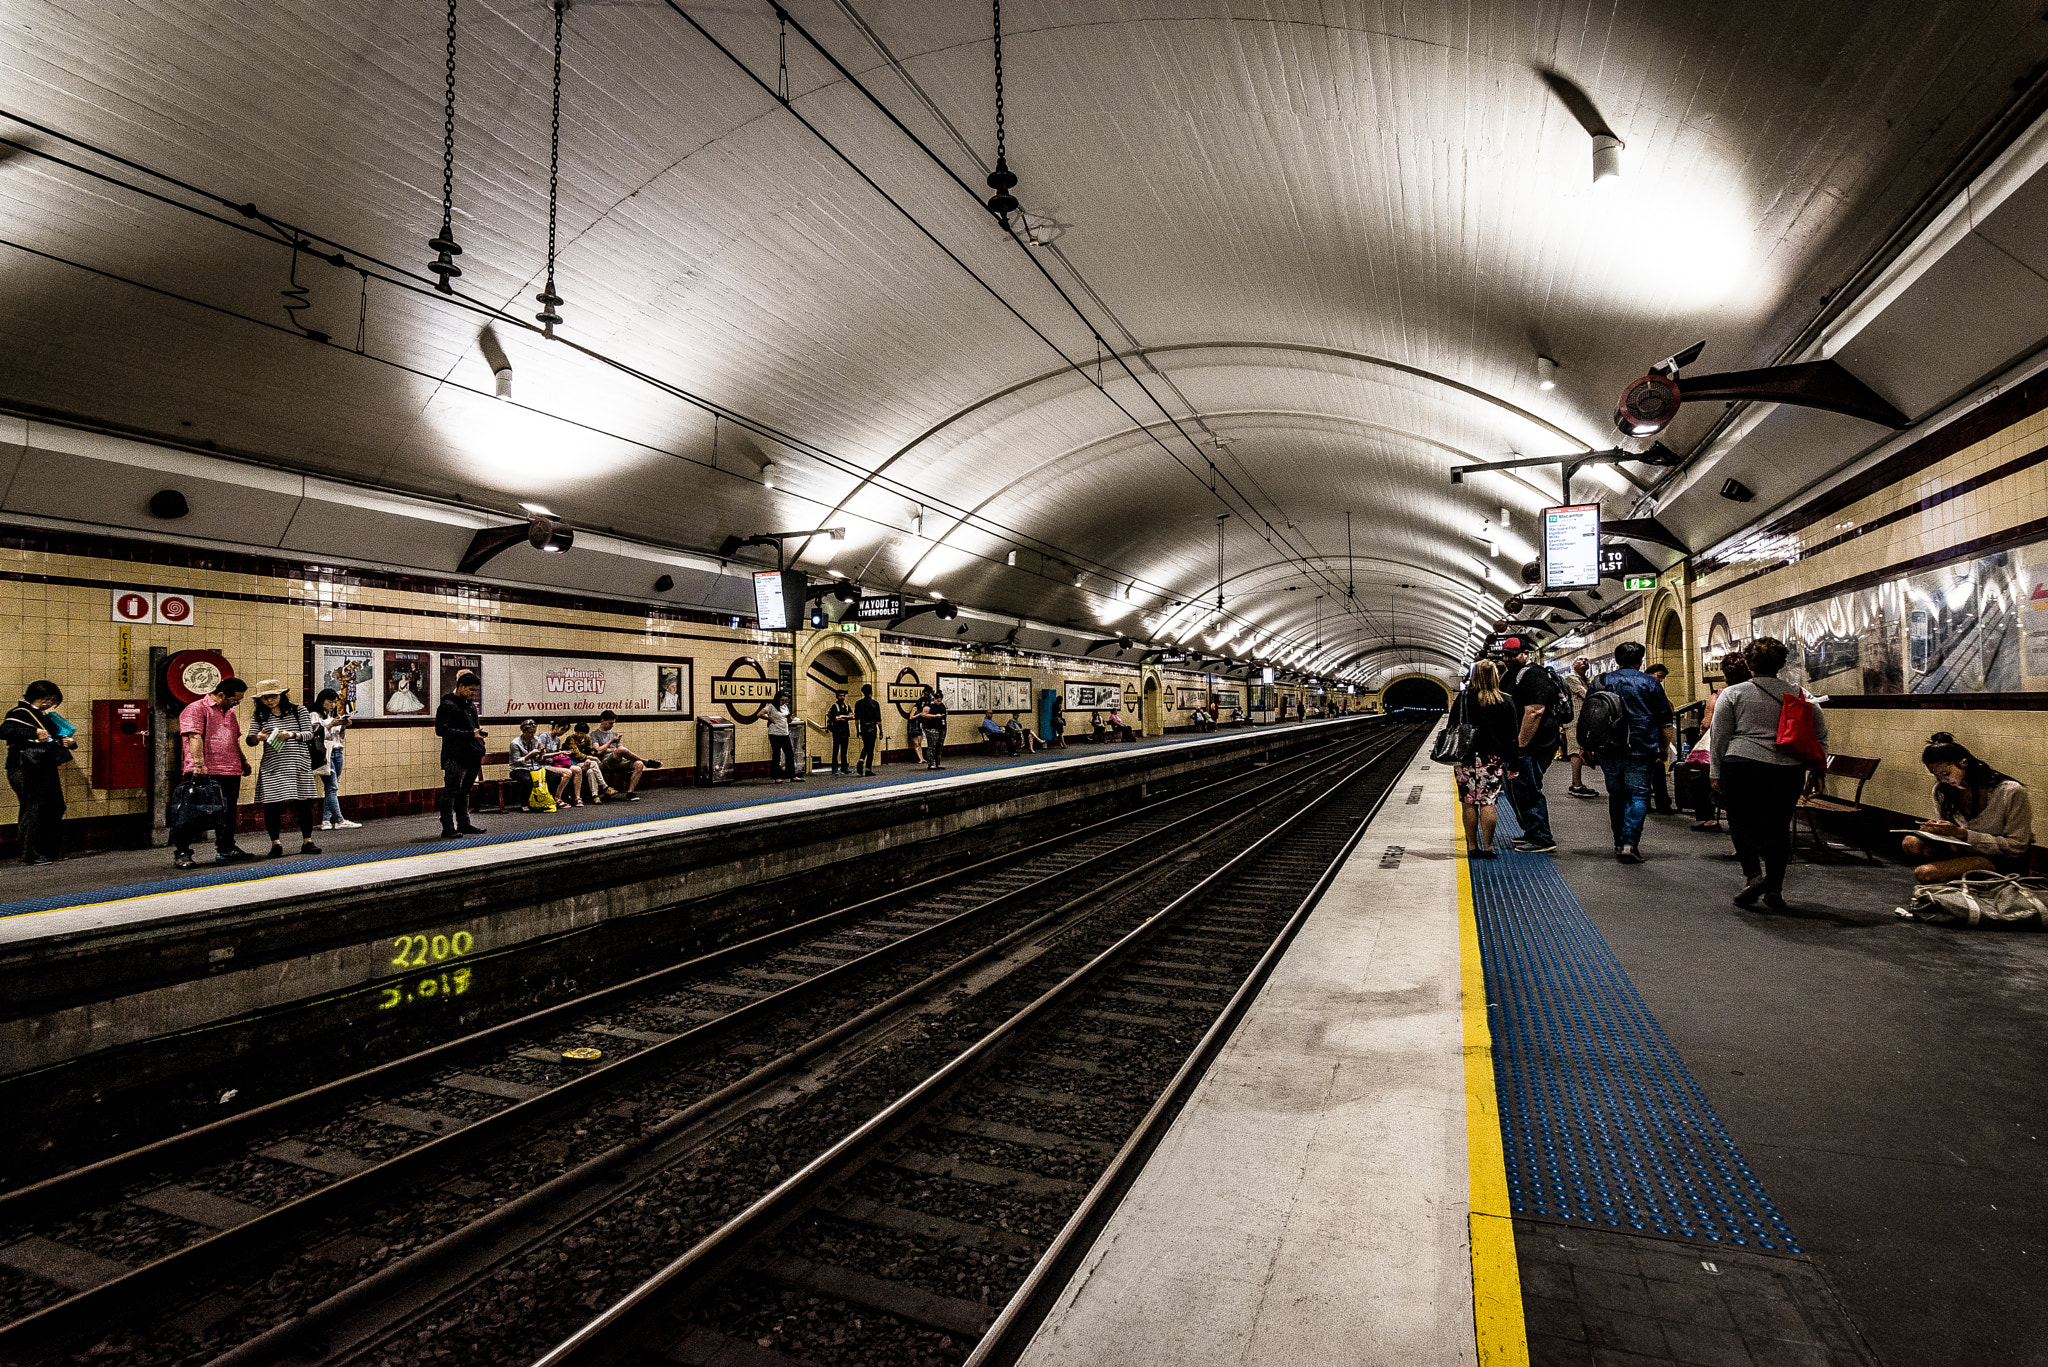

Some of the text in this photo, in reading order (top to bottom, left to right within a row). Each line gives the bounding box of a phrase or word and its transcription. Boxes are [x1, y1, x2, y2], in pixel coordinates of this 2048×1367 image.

[1608, 552, 1622, 560] TO
[564, 668, 604, 678] Women's
[547, 677, 606, 694] Weekly
[720, 684, 771, 696] MUSEUM
[504, 699, 650, 714] for women who want it all!
[392, 931, 473, 968] 2200
